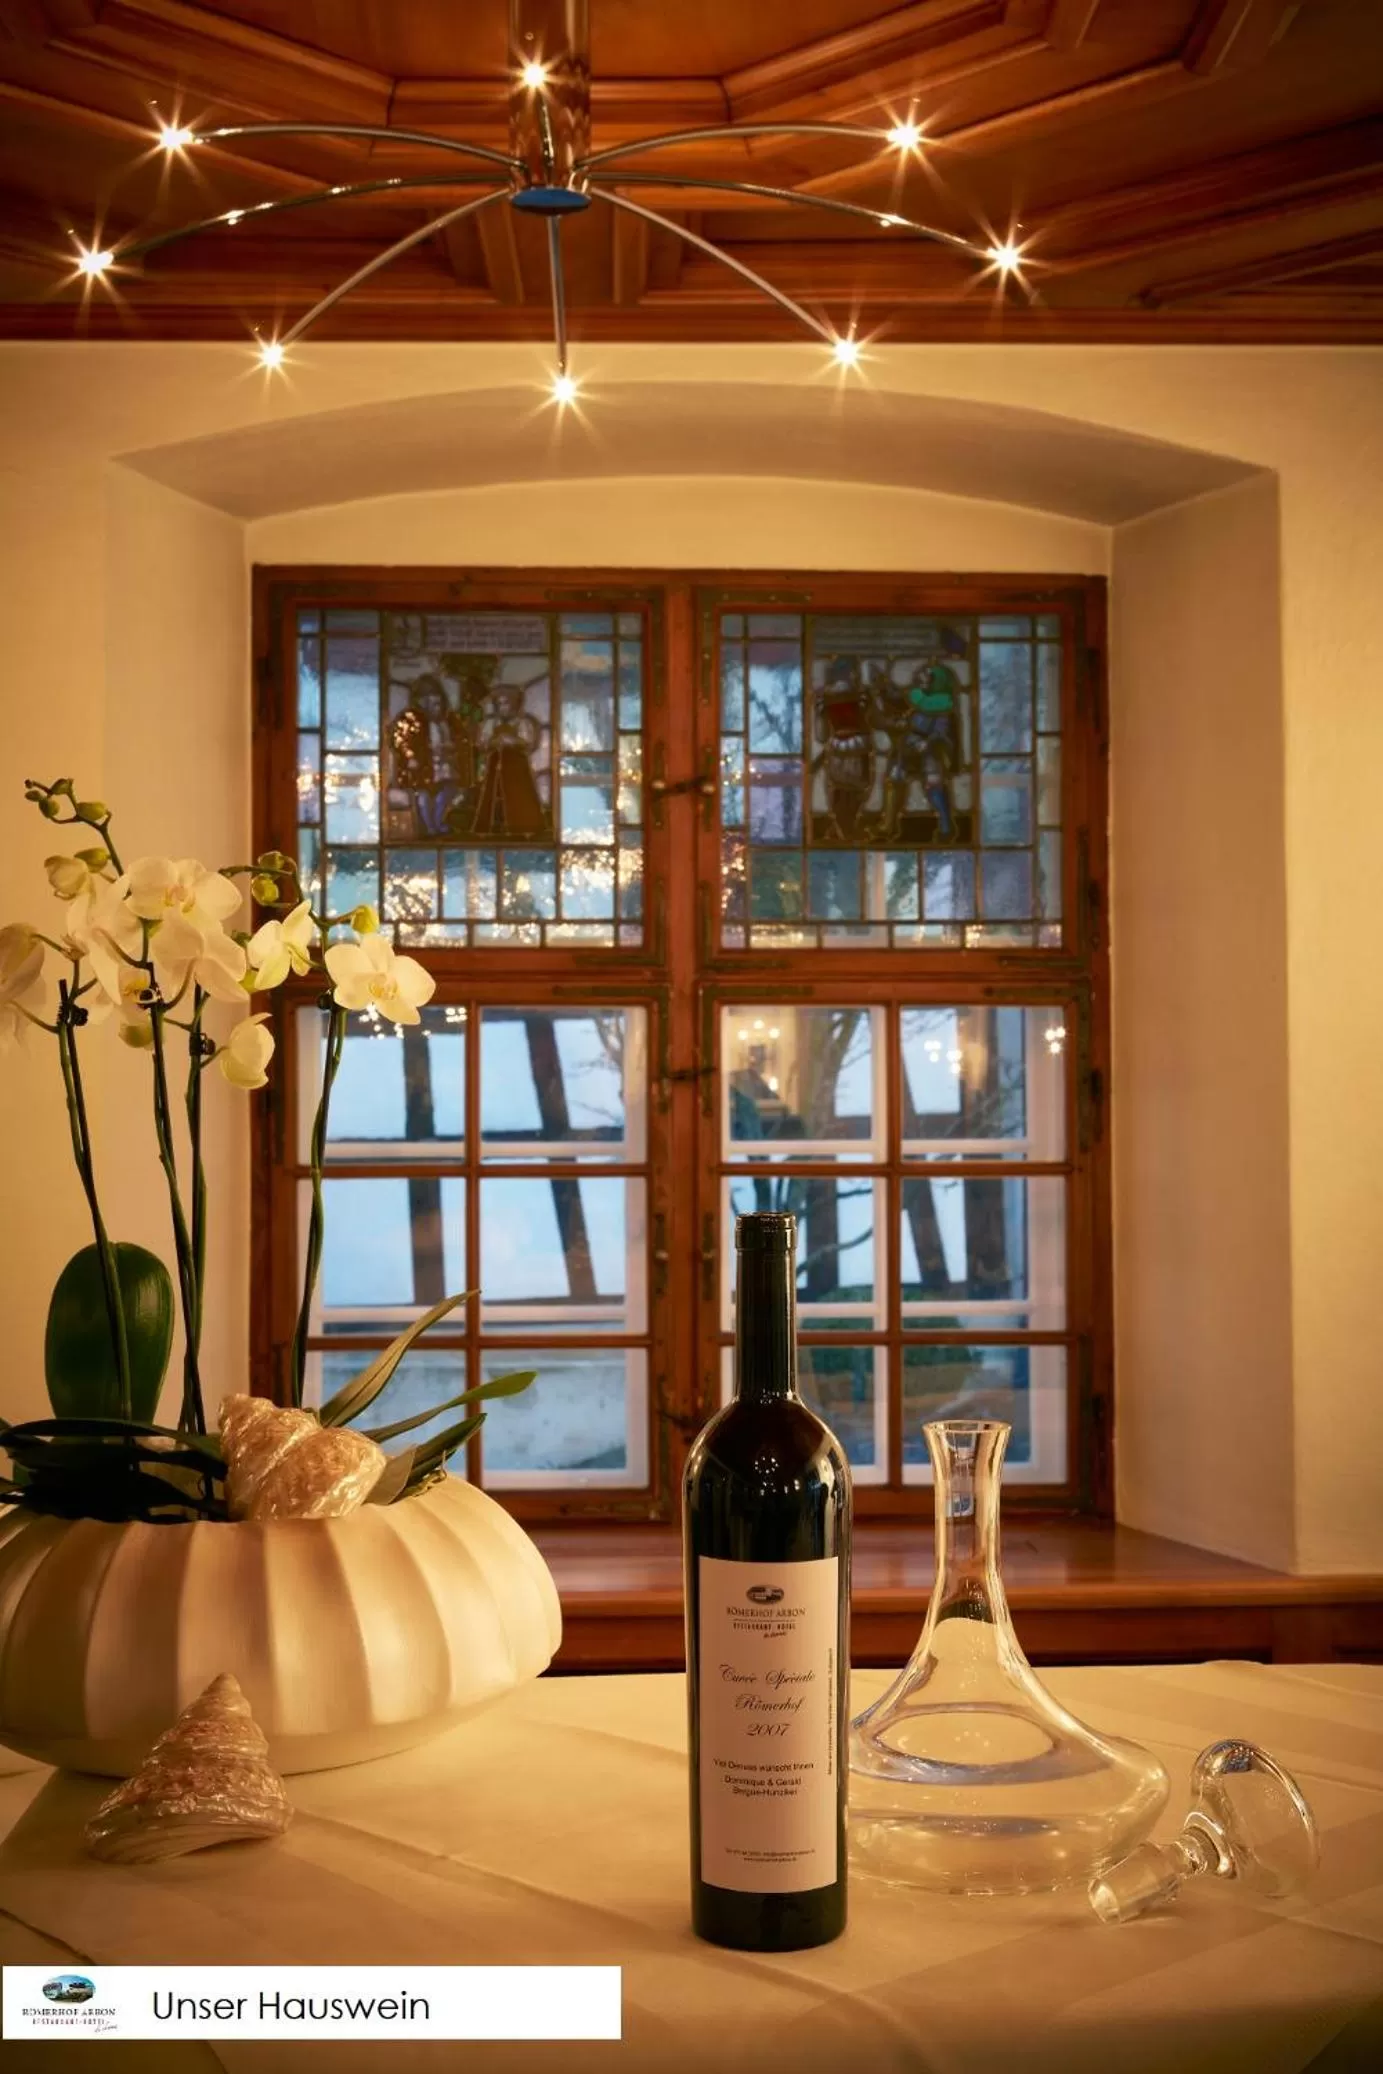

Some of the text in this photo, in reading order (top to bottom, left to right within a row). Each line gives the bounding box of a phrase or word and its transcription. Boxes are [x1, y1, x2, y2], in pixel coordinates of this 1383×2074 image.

[776, 1606, 806, 1617] ARBON
[735, 1693, 806, 1712] Römerhof
[746, 1722, 790, 1737] 2007
[767, 1777, 774, 1786] &
